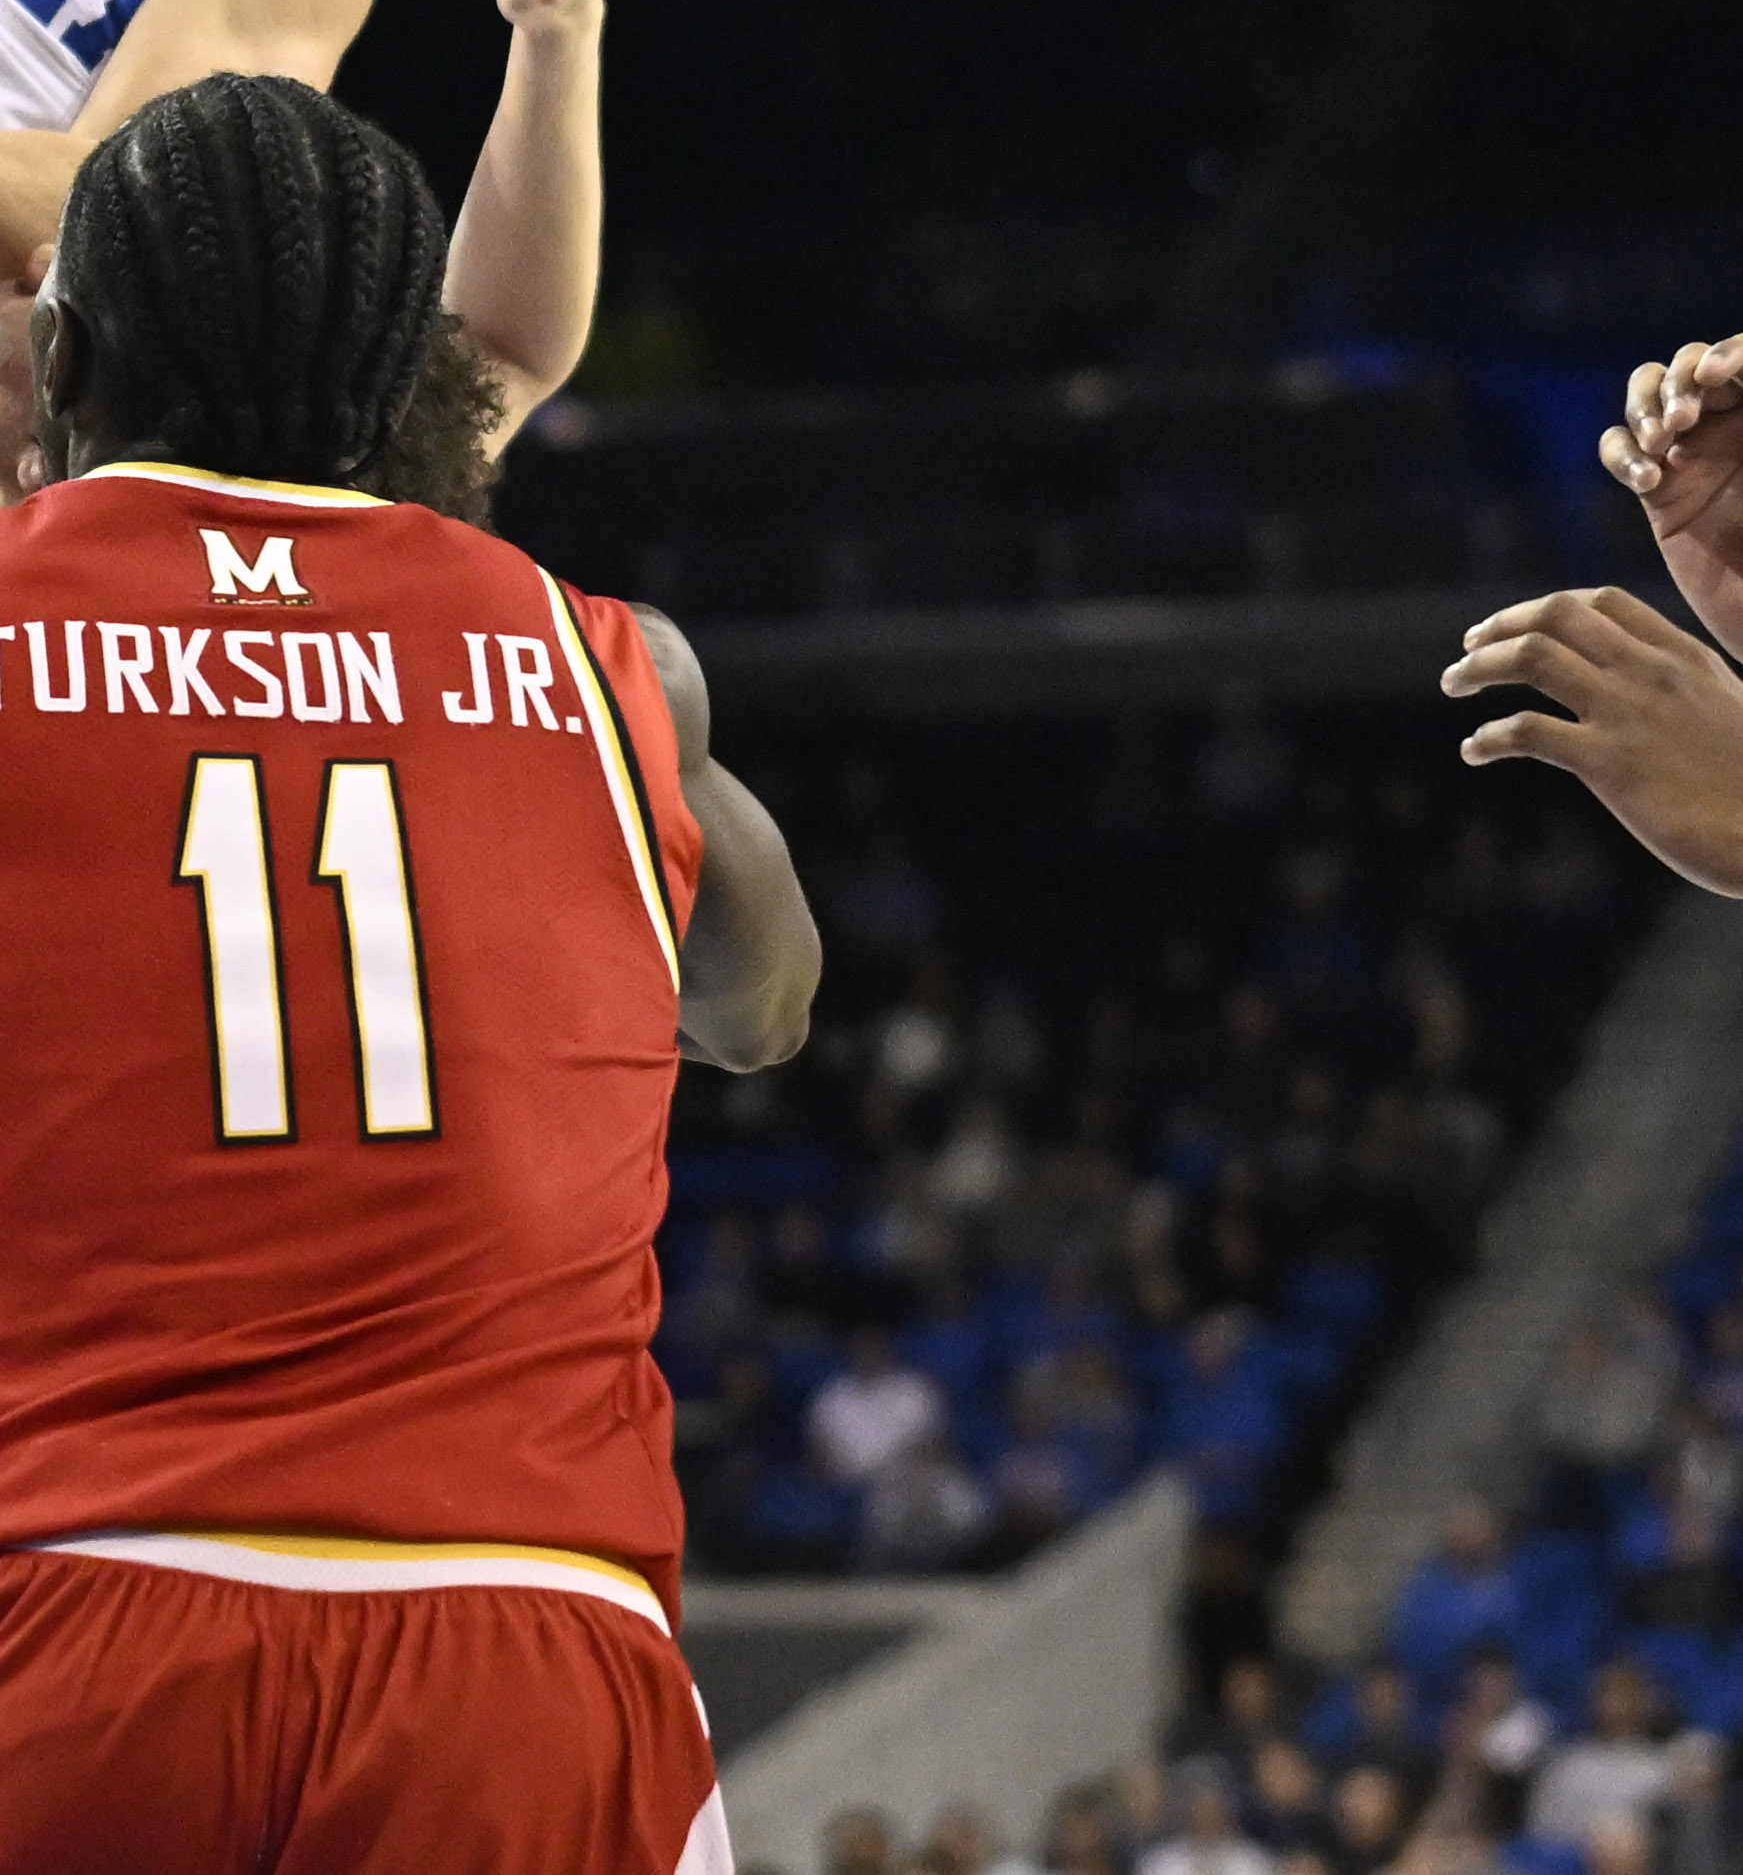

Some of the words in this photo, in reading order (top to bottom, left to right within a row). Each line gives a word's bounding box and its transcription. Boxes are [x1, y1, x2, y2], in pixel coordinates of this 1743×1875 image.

[198, 528, 308, 602] M
[442, 630, 585, 736] JR.
[170, 751, 442, 1145] 11
